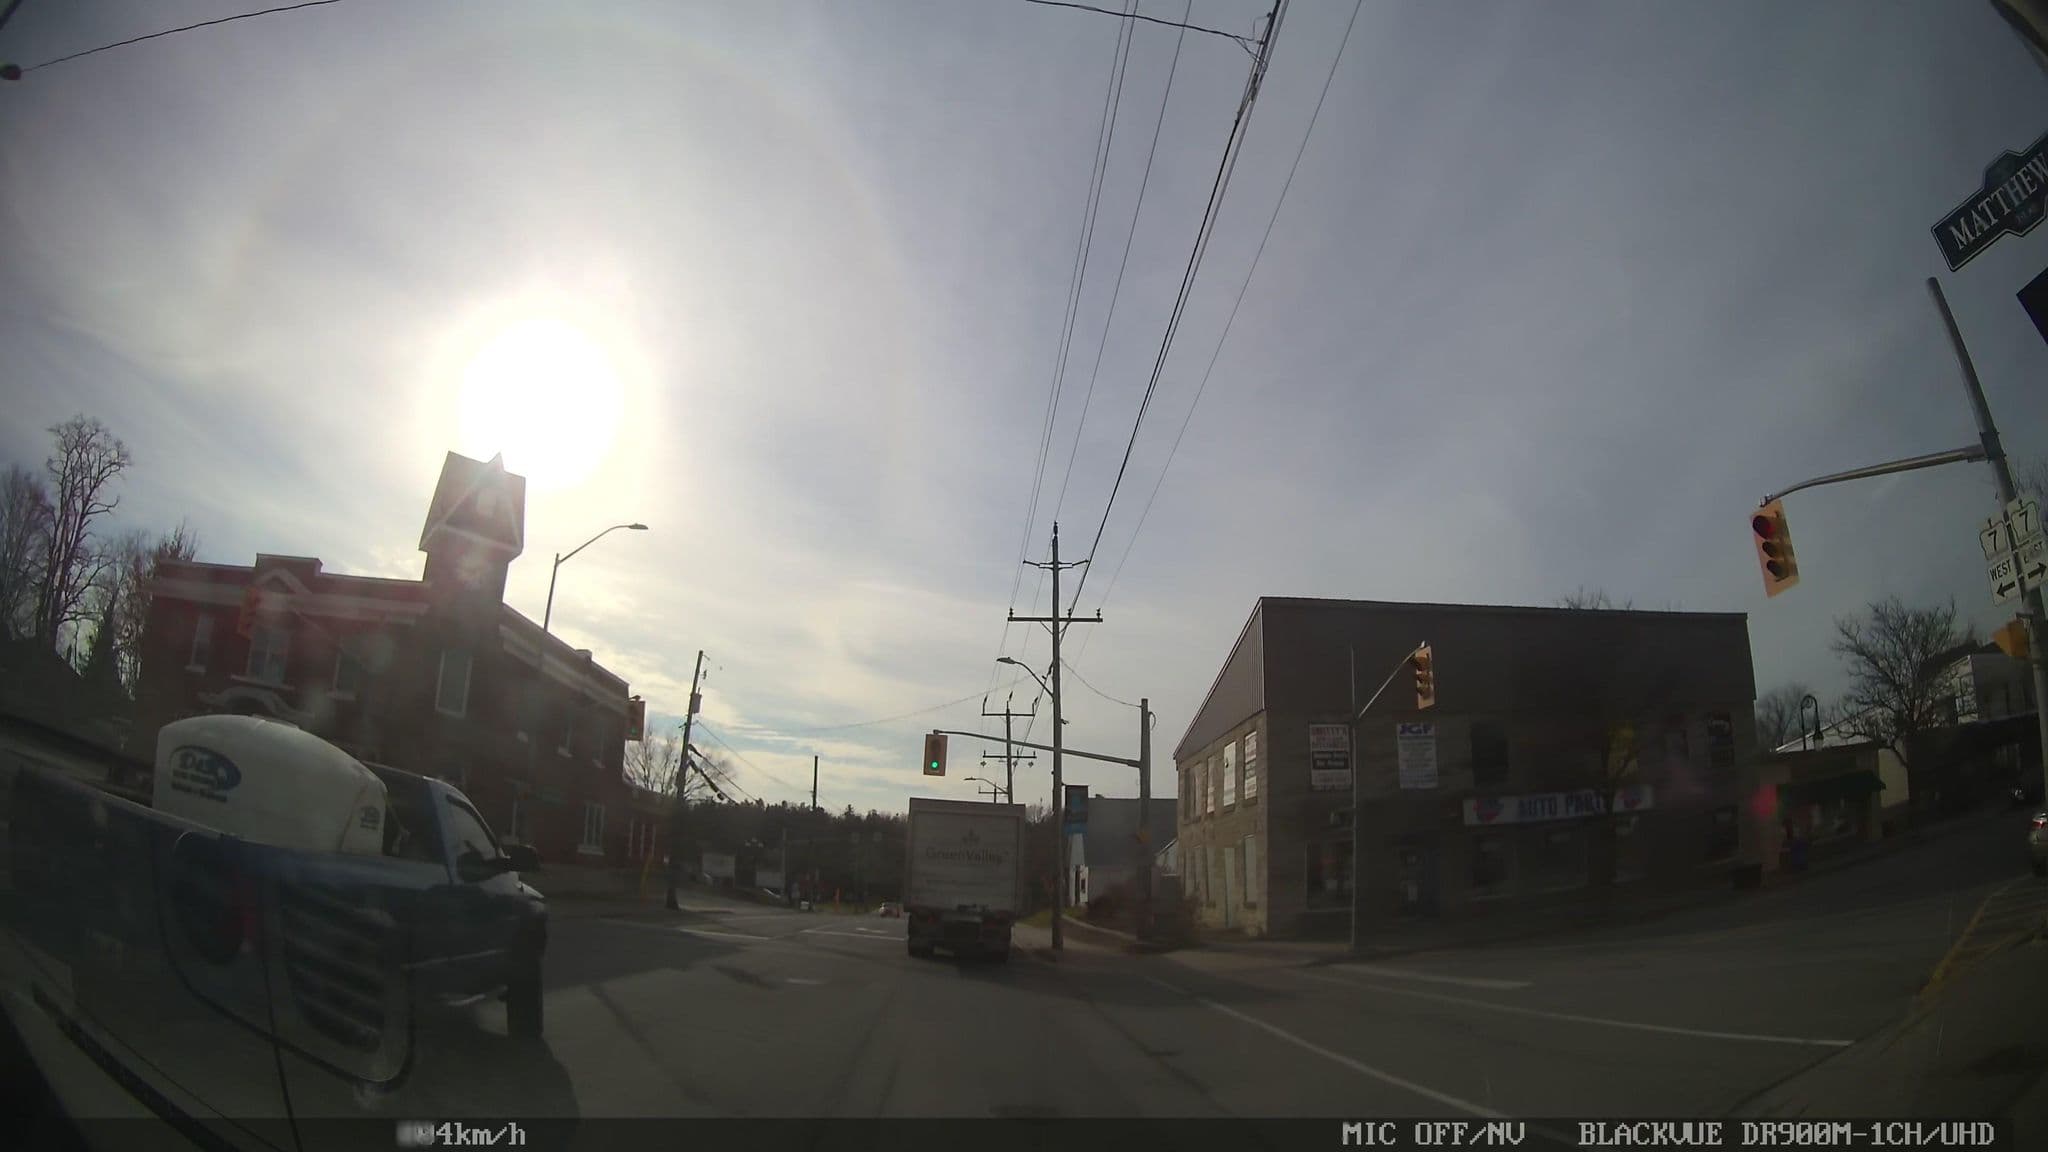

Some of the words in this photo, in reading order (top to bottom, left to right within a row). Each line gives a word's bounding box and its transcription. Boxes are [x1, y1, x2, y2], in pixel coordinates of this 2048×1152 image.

[2018, 510, 2029, 532] 7
[1988, 530, 1998, 553] 7
[1989, 559, 2012, 581] WEST
[1518, 796, 1558, 820] AUTO
